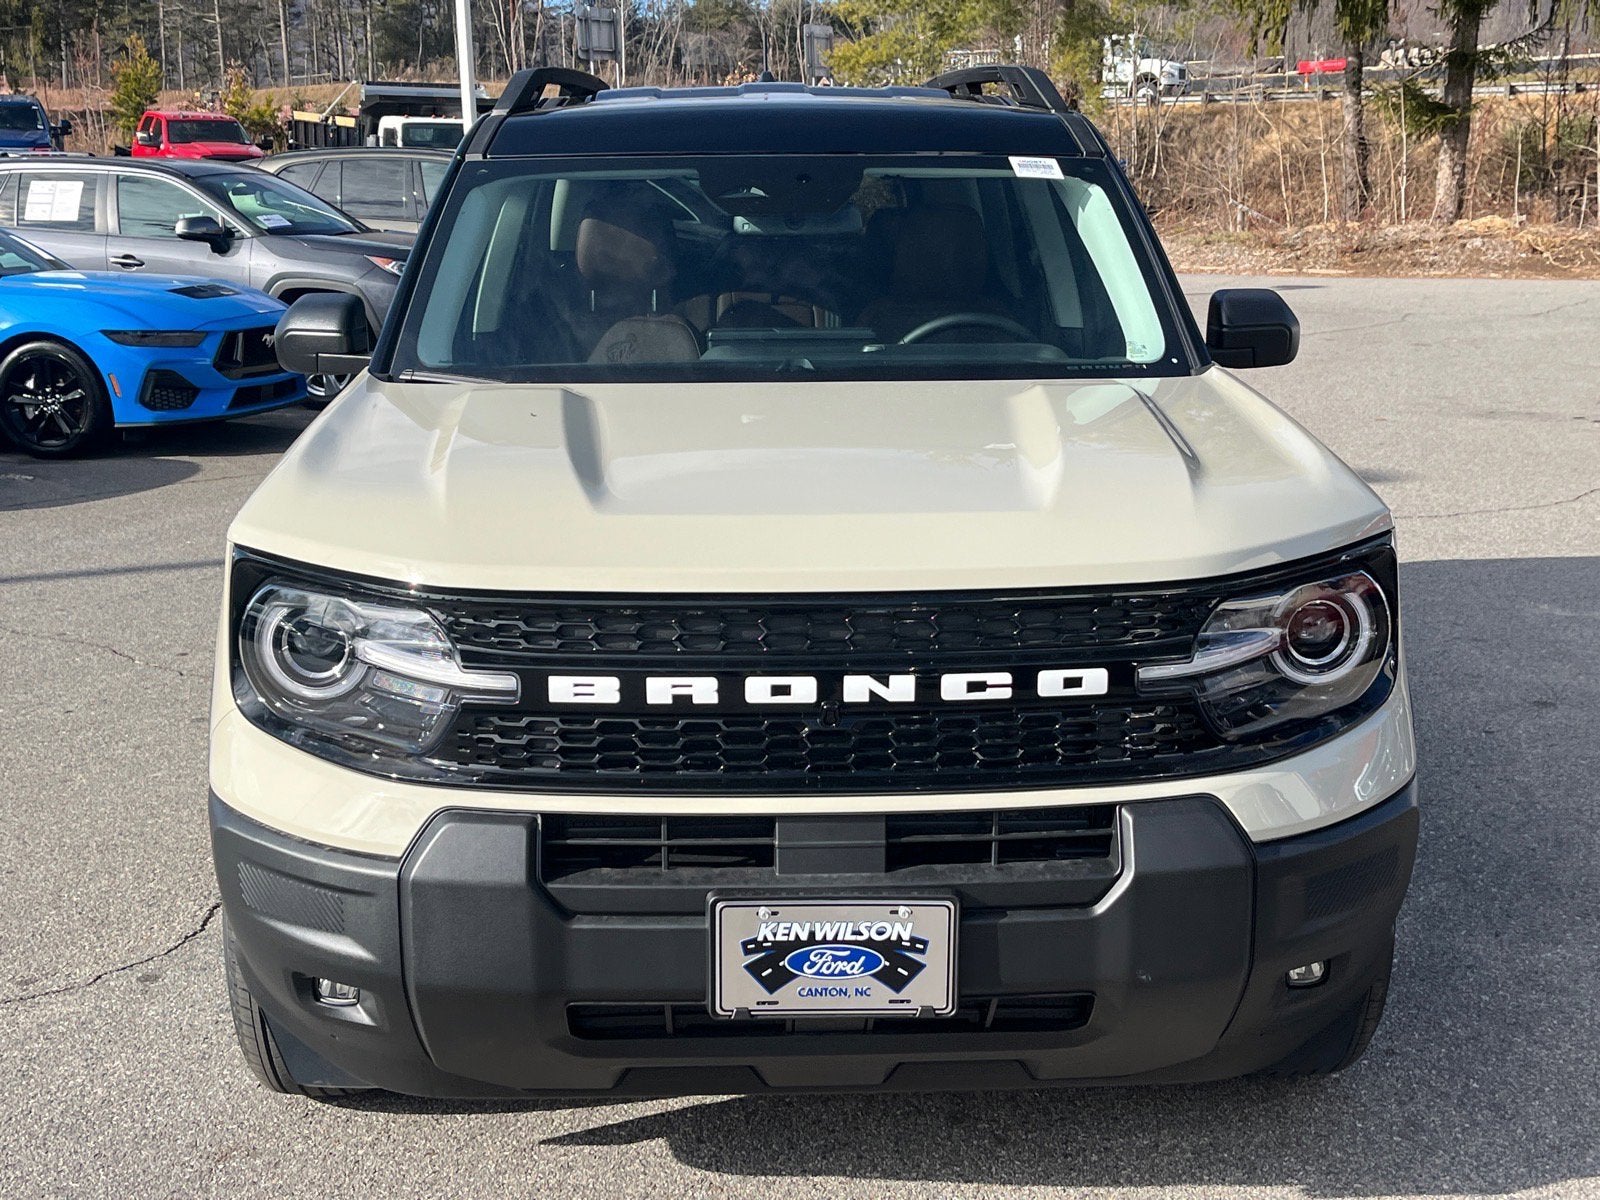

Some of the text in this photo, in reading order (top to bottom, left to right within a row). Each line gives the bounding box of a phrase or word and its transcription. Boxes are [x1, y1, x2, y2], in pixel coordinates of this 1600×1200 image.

[547, 668, 1109, 705] BRONCO
[757, 921, 913, 942] KEN WILSON
[803, 949, 866, 975] Ford
[798, 987, 872, 998] CANTON, NC
